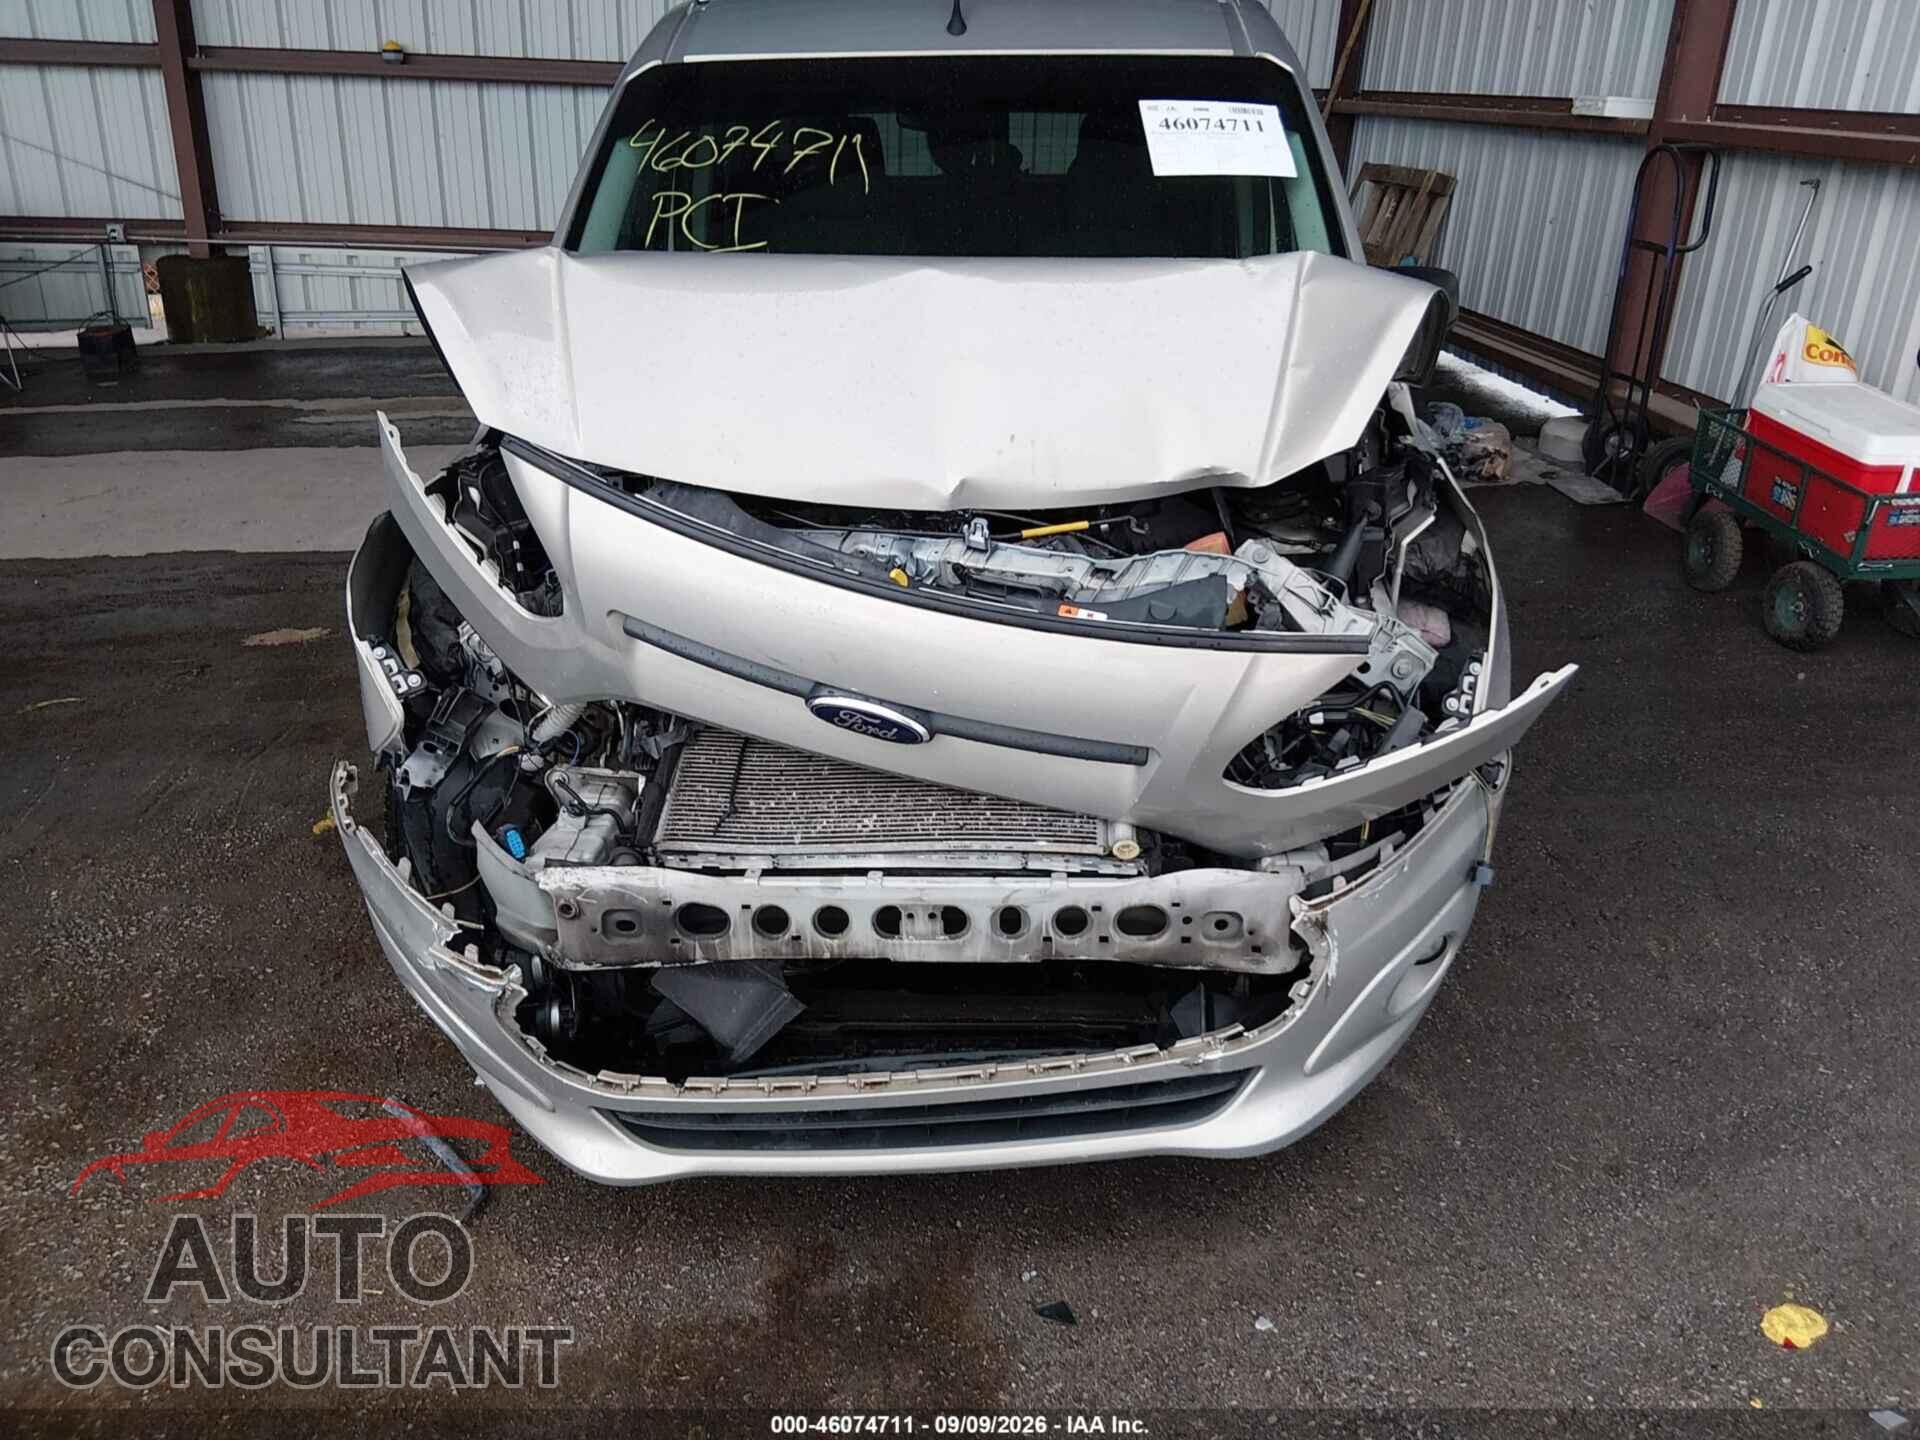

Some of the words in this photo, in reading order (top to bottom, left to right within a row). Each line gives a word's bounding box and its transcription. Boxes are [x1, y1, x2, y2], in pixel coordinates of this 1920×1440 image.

[1158, 116, 1265, 134] 46074711
[629, 118, 870, 195] 46074711
[645, 190, 781, 253] PCI
[833, 710, 897, 741] Ford
